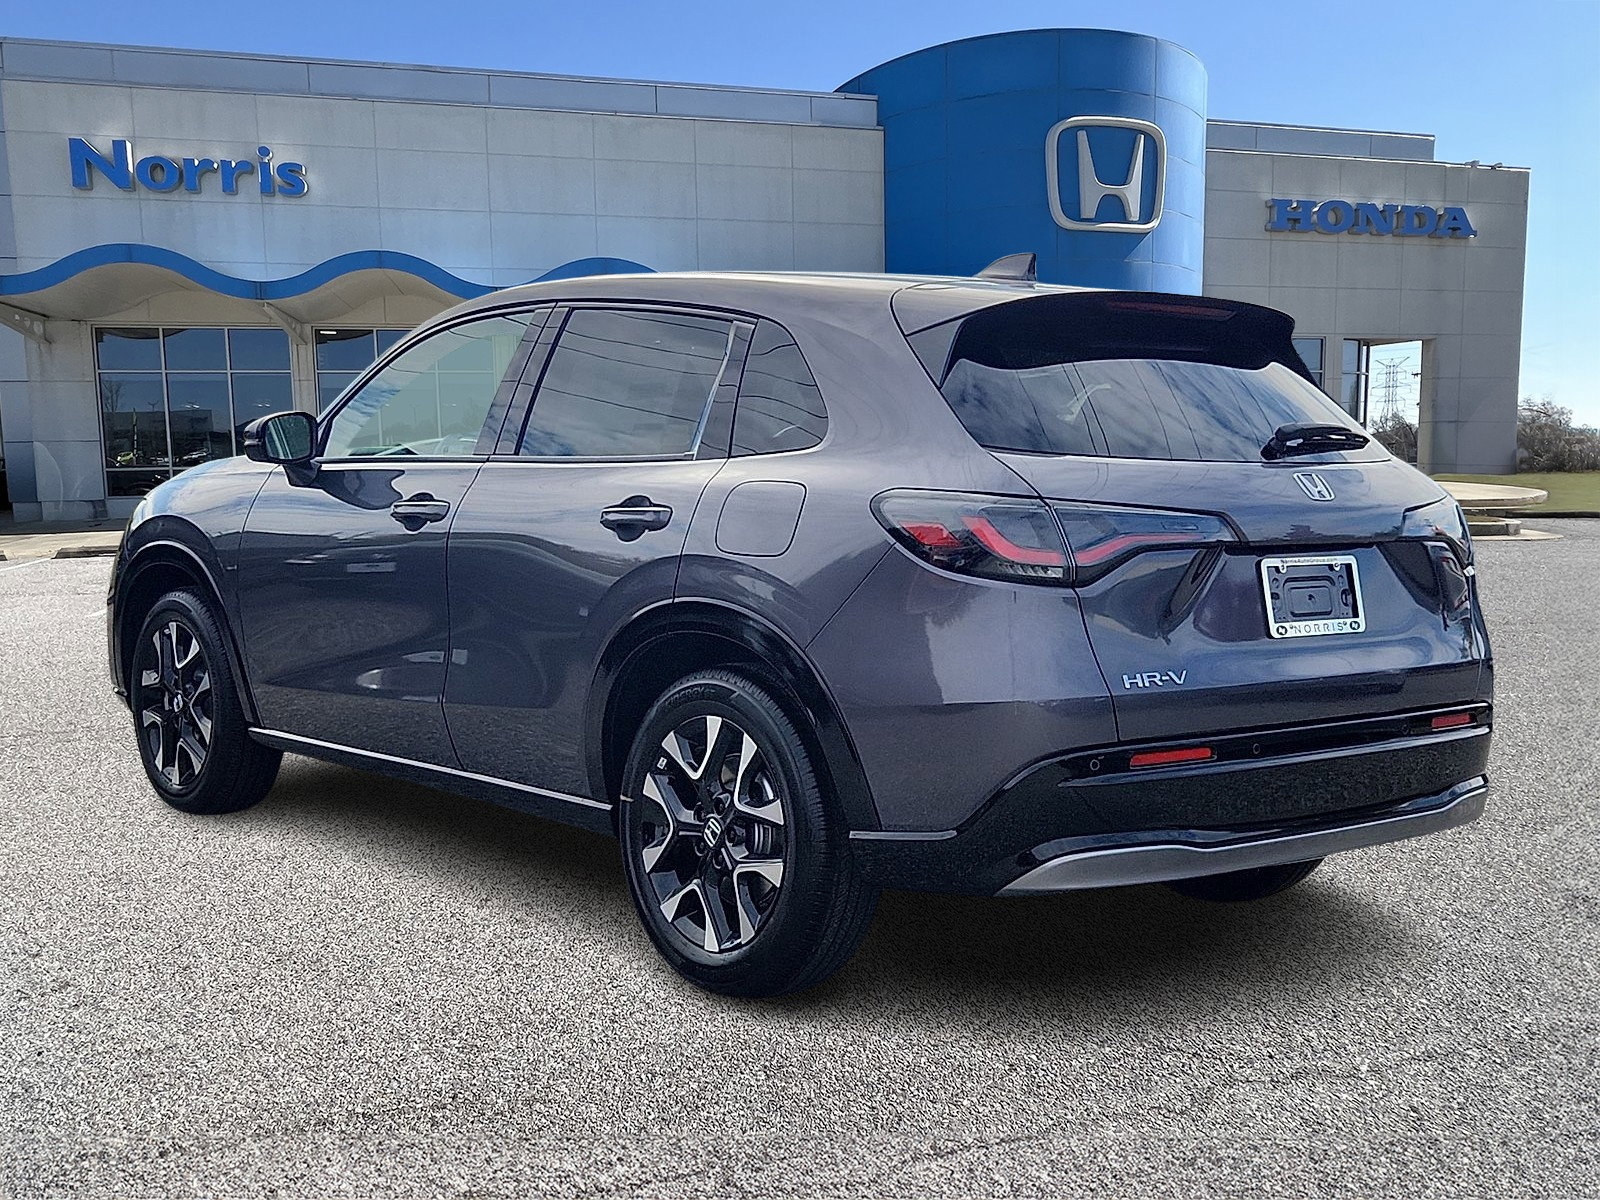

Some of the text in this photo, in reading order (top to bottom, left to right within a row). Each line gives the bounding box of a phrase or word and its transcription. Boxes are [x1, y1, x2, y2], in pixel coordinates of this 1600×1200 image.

[68, 137, 309, 197] Norris
[1265, 198, 1477, 239] HONDA
[1294, 622, 1344, 634] NORRIS
[1122, 670, 1187, 689] HR-V
